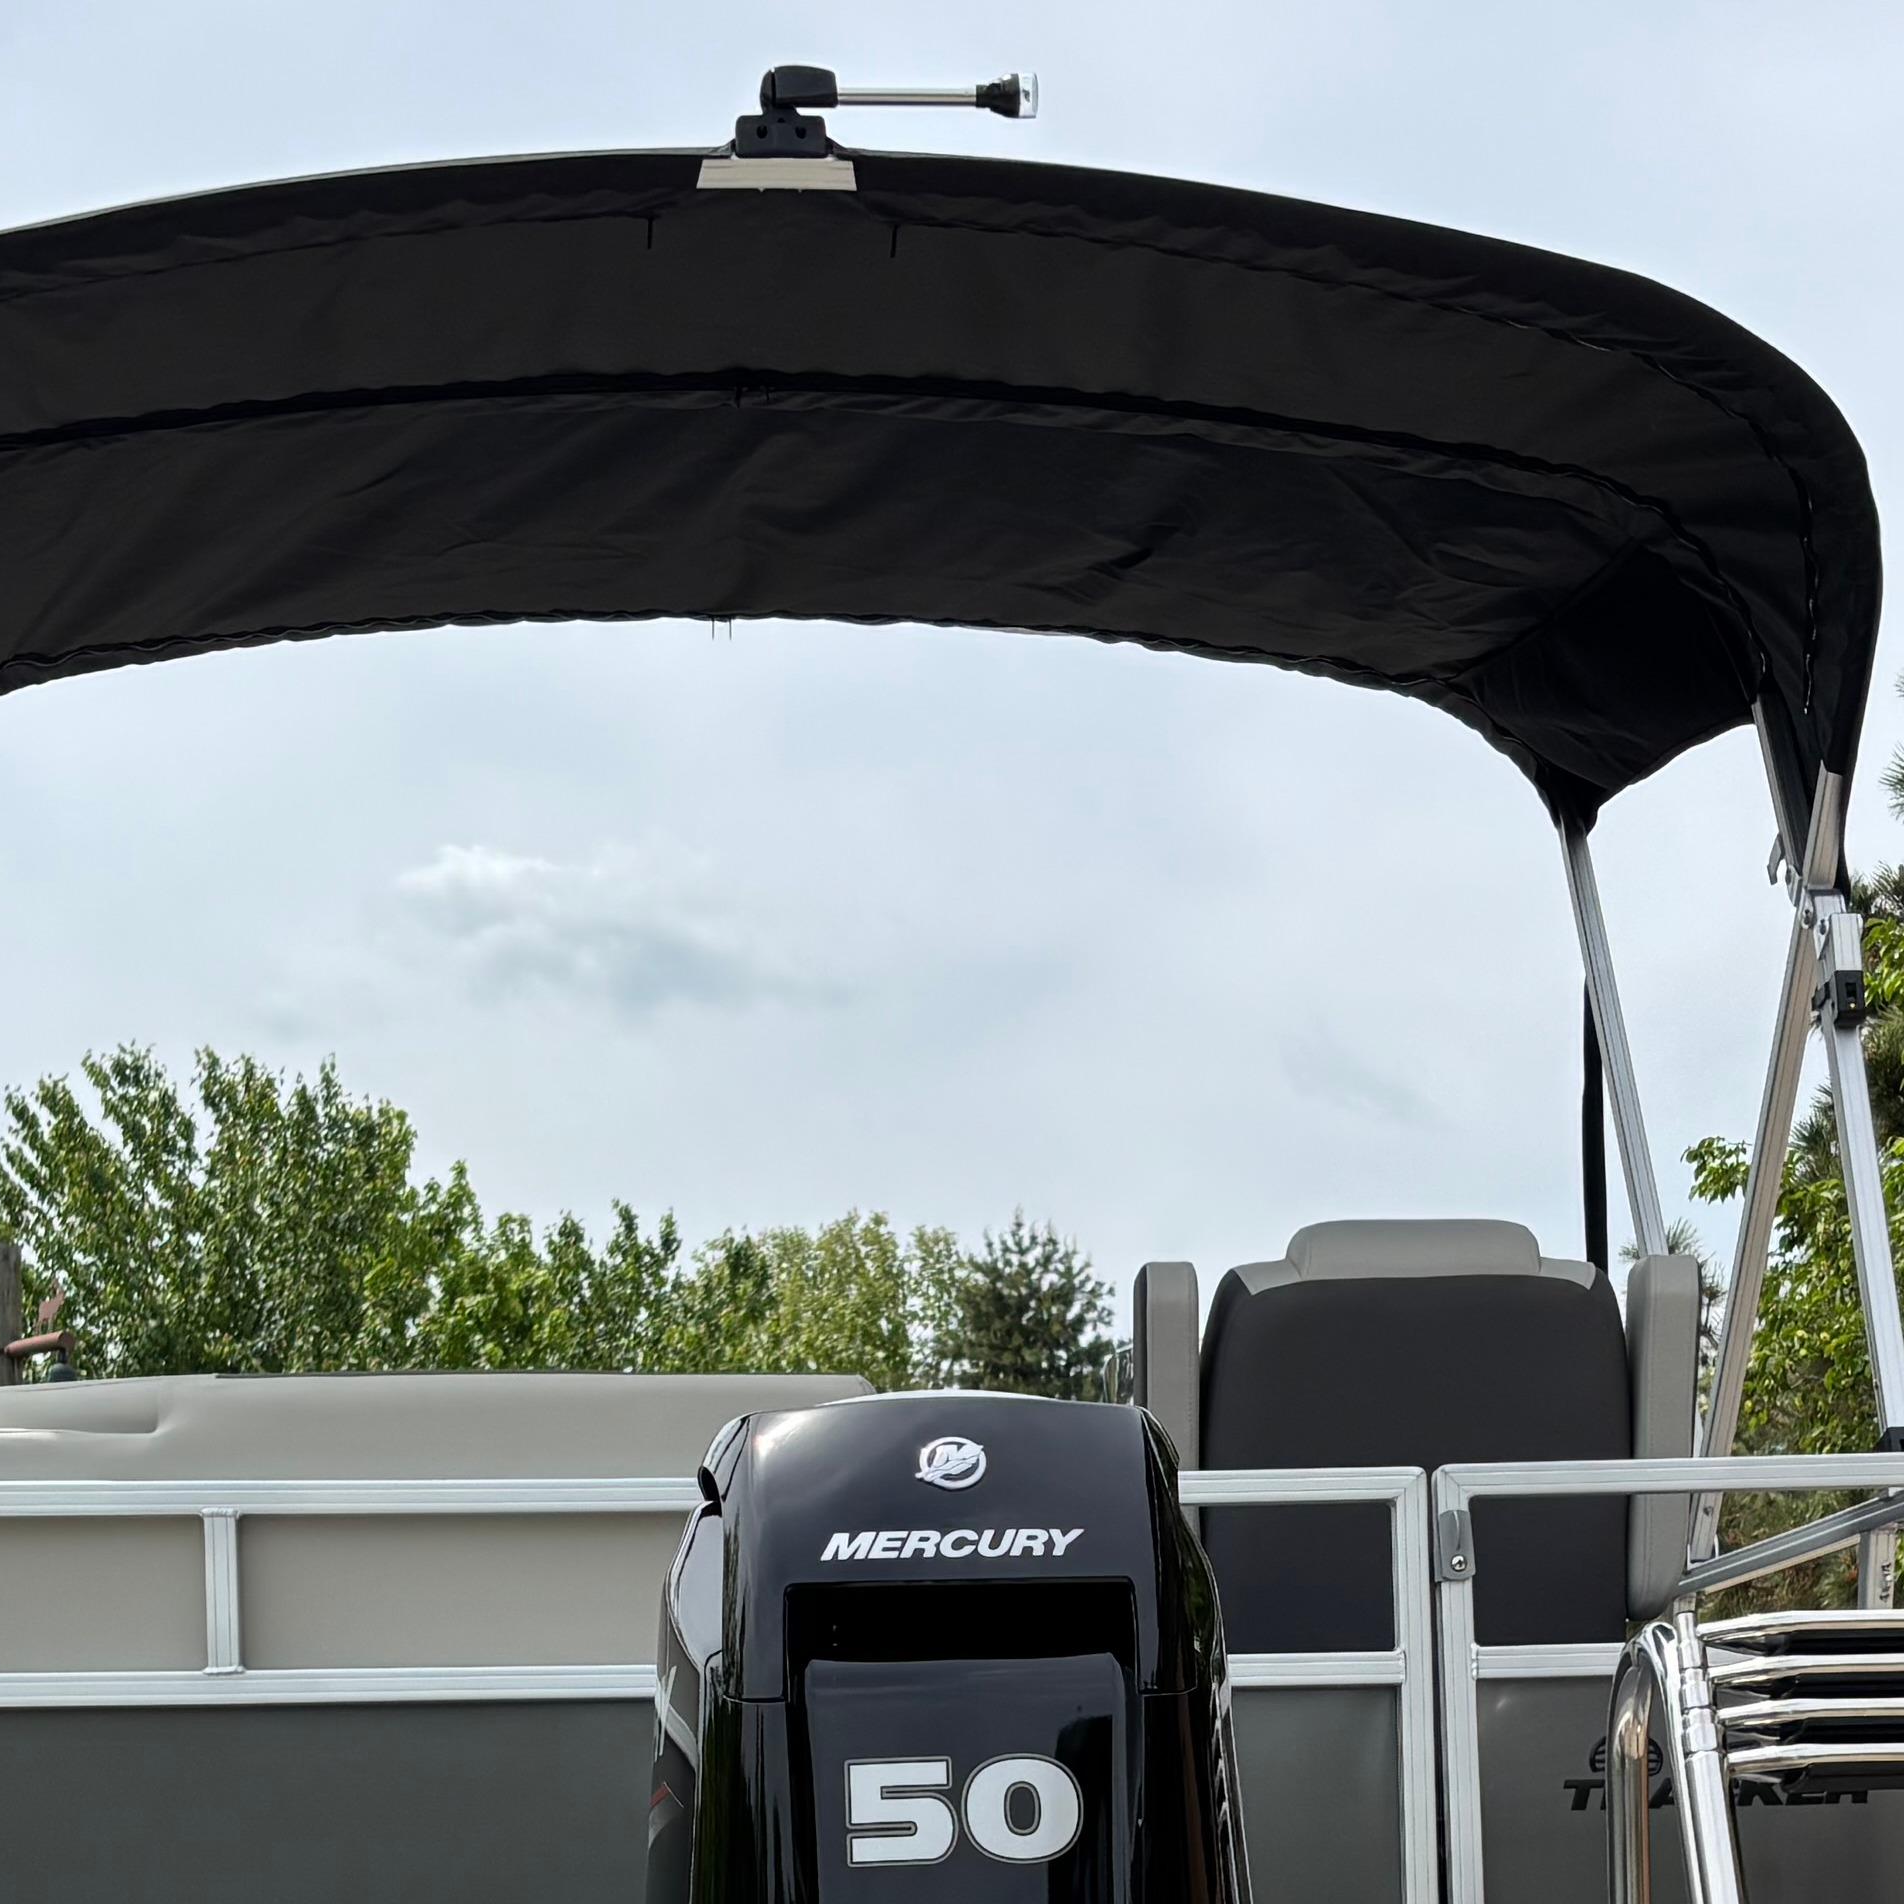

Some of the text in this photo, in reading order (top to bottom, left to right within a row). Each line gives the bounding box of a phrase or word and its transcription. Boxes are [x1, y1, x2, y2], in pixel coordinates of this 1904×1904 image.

[821, 1529, 1084, 1561] MERCURY
[844, 1753, 1084, 1867] 50
[1563, 1777, 1868, 1811] TAKE
